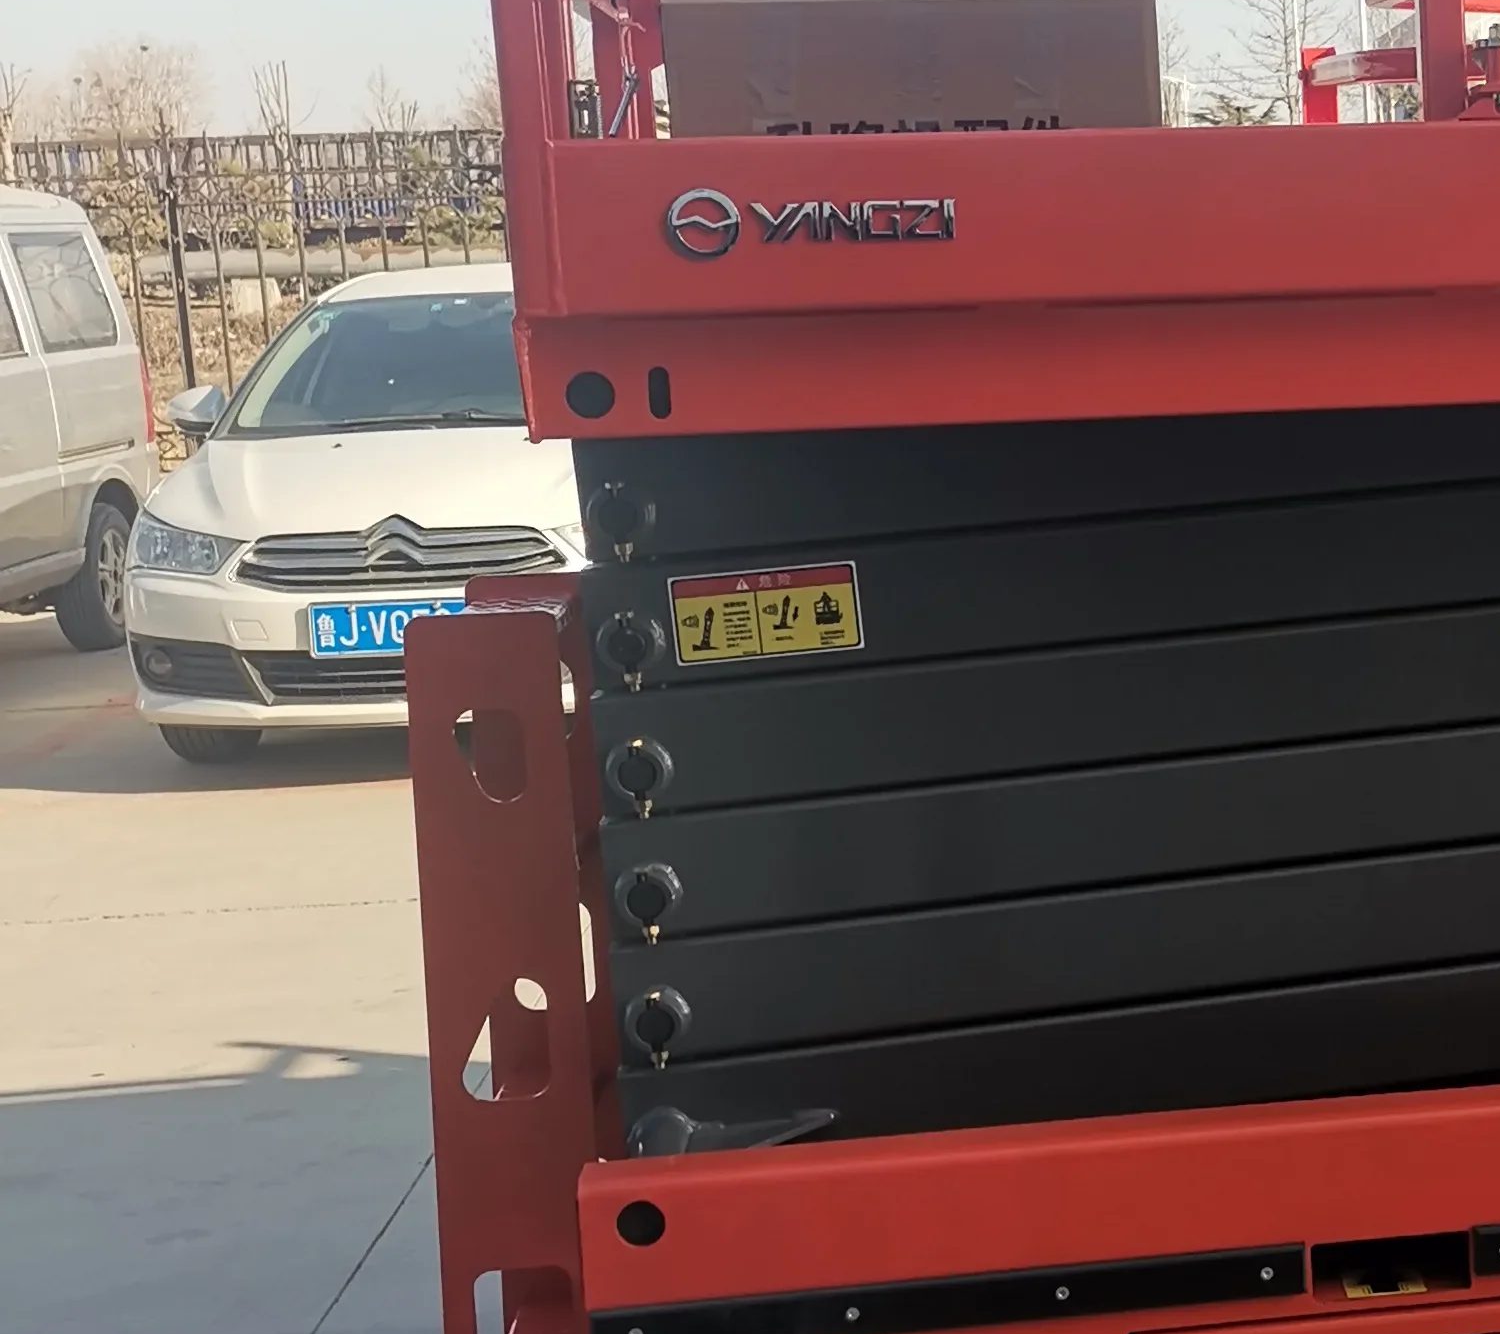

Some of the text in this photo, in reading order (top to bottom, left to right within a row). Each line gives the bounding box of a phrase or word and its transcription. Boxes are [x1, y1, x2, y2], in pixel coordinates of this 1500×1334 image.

[750, 198, 956, 244] YANGZI
[758, 572, 792, 588] 危险
[317, 608, 452, 650] 鲁J·VQ
